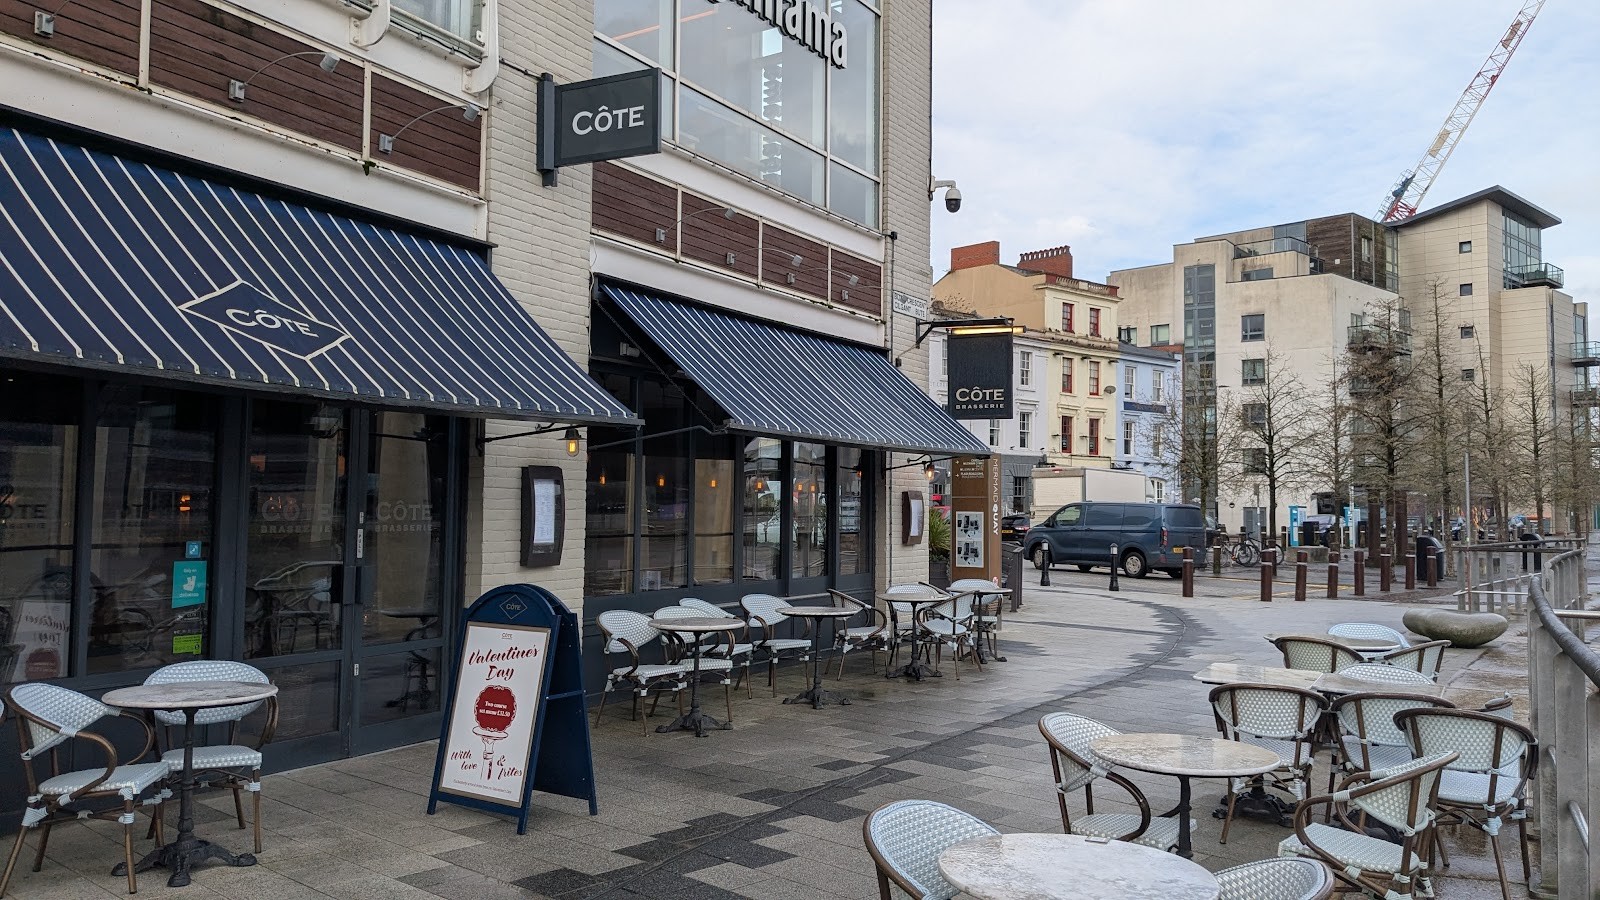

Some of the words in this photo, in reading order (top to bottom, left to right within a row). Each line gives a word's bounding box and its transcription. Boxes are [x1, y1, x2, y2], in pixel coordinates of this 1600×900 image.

[572, 105, 645, 136] CÔTE
[225, 308, 320, 337] CÔTE
[955, 386, 1005, 402] CÔTE
[377, 501, 432, 521] CÔTE
[374, 524, 433, 533] BRASSERIE
[469, 645, 539, 665] Valentine's
[486, 665, 514, 681] Day
[461, 761, 478, 770] love
[497, 755, 506, 766] &
[498, 767, 522, 780] frites
